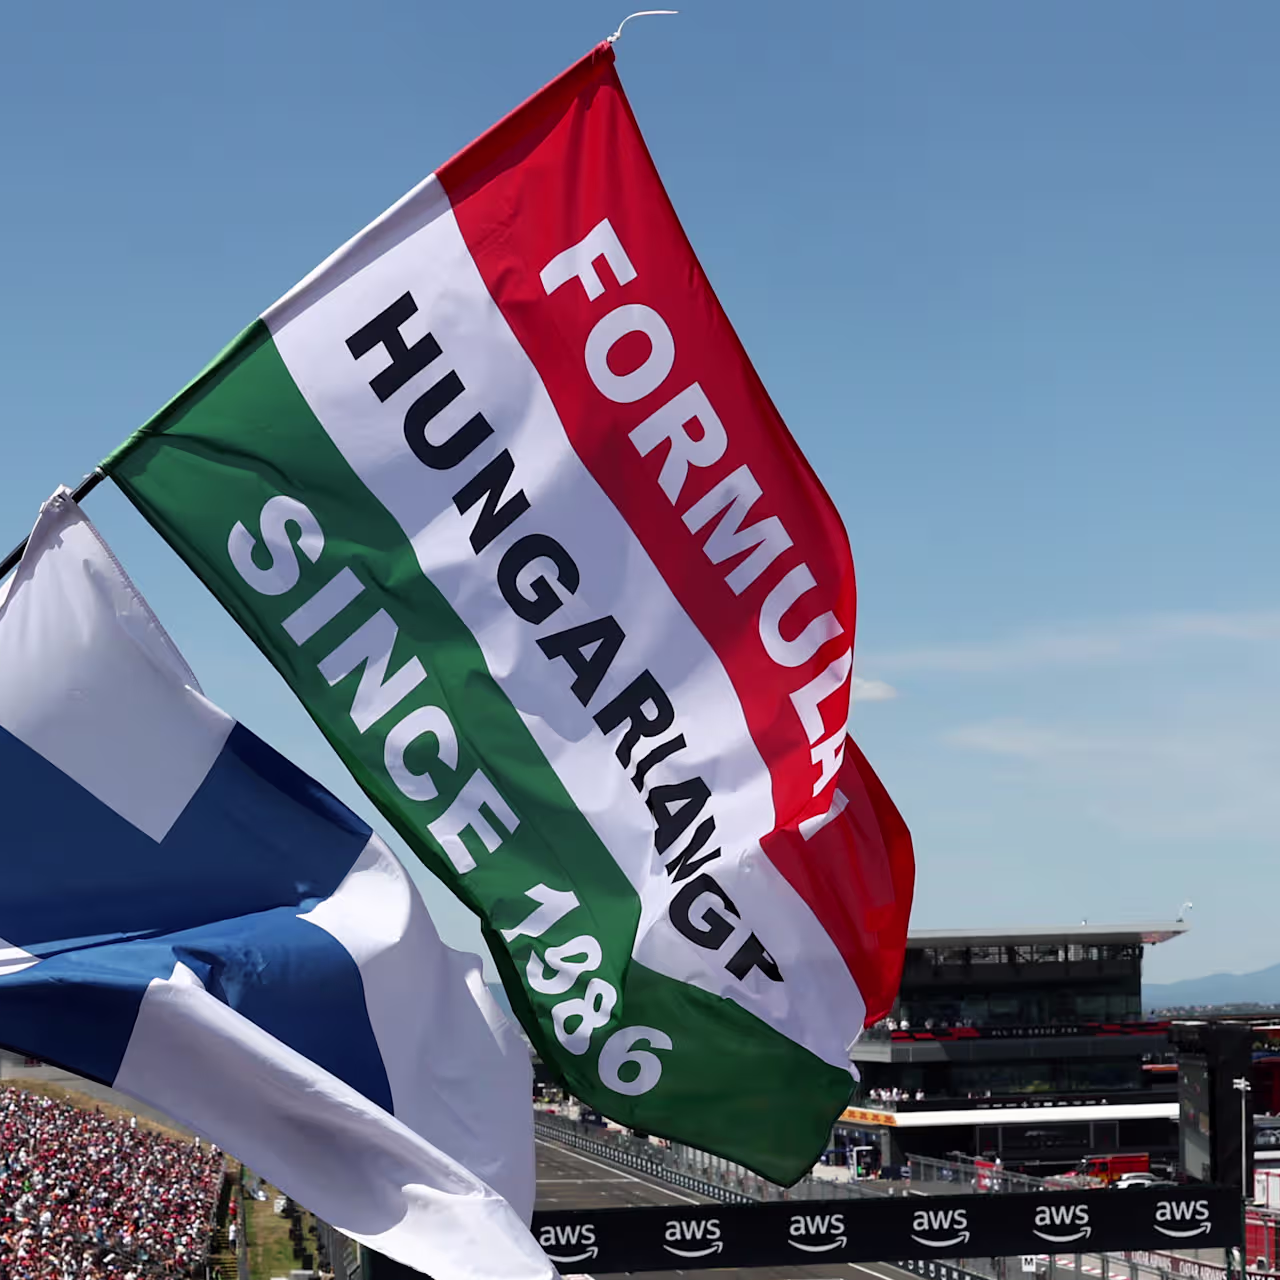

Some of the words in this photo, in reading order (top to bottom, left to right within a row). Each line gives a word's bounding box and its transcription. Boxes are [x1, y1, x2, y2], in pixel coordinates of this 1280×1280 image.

[539, 216, 853, 798] FORMULA
[227, 494, 520, 875] SINCE
[499, 883, 674, 1097] 1986
[912, 1209, 969, 1231] aws
[1034, 1204, 1089, 1227] aws
[1155, 1200, 1210, 1221] aws
[539, 1224, 596, 1246] aws
[664, 1219, 722, 1240] aws
[789, 1214, 845, 1236] aws
